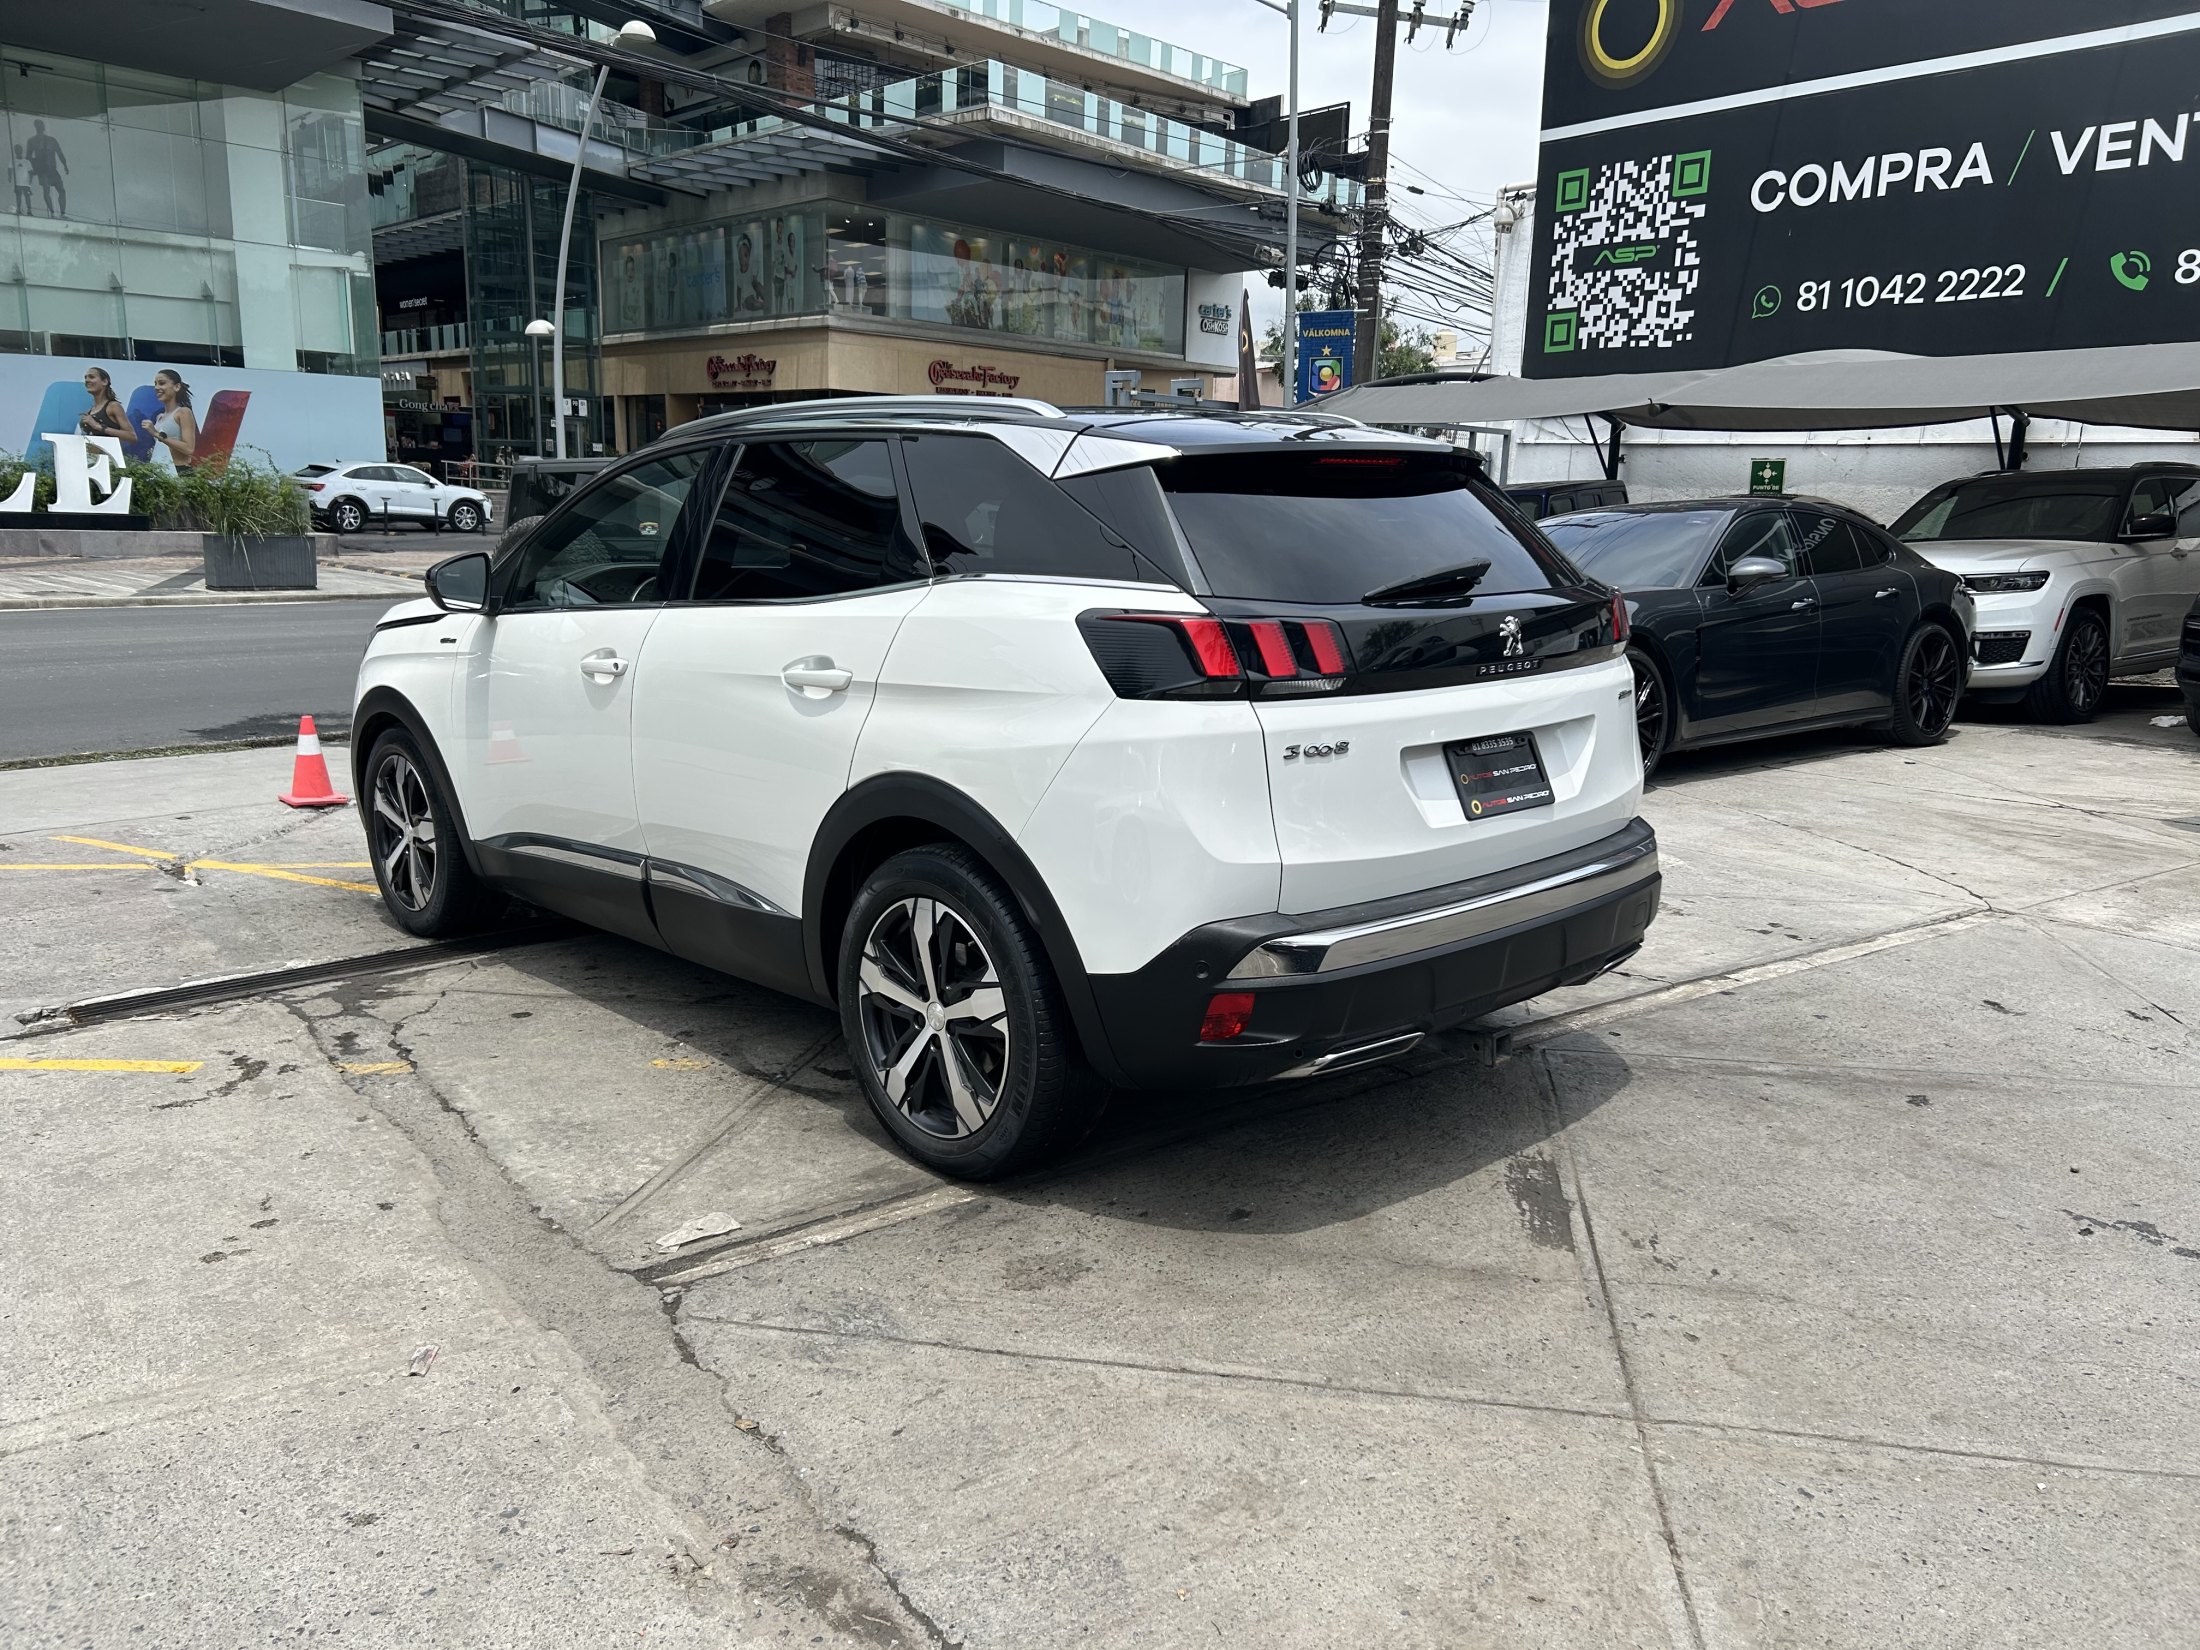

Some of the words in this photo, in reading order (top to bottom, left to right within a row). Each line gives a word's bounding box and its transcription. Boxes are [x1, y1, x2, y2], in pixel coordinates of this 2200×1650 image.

[1750, 141, 1994, 213] COMPRA
[1593, 245, 1660, 266] ASP
[1797, 280, 1831, 311] 81
[1840, 272, 1926, 308] 1042
[1935, 264, 2026, 303] 2222
[1303, 328, 1350, 337] VÄLKOMNA
[979, 365, 1020, 389] Factory
[399, 399, 428, 413] Gong
[429, 401, 448, 411] cha
[1480, 660, 1539, 675] PEUGEOT
[1283, 740, 1350, 760] 3008
[1472, 742, 1481, 751] 81
[1499, 737, 1514, 747] 3535
[1493, 768, 1509, 777] SAN
[1507, 795, 1524, 803] SAN
